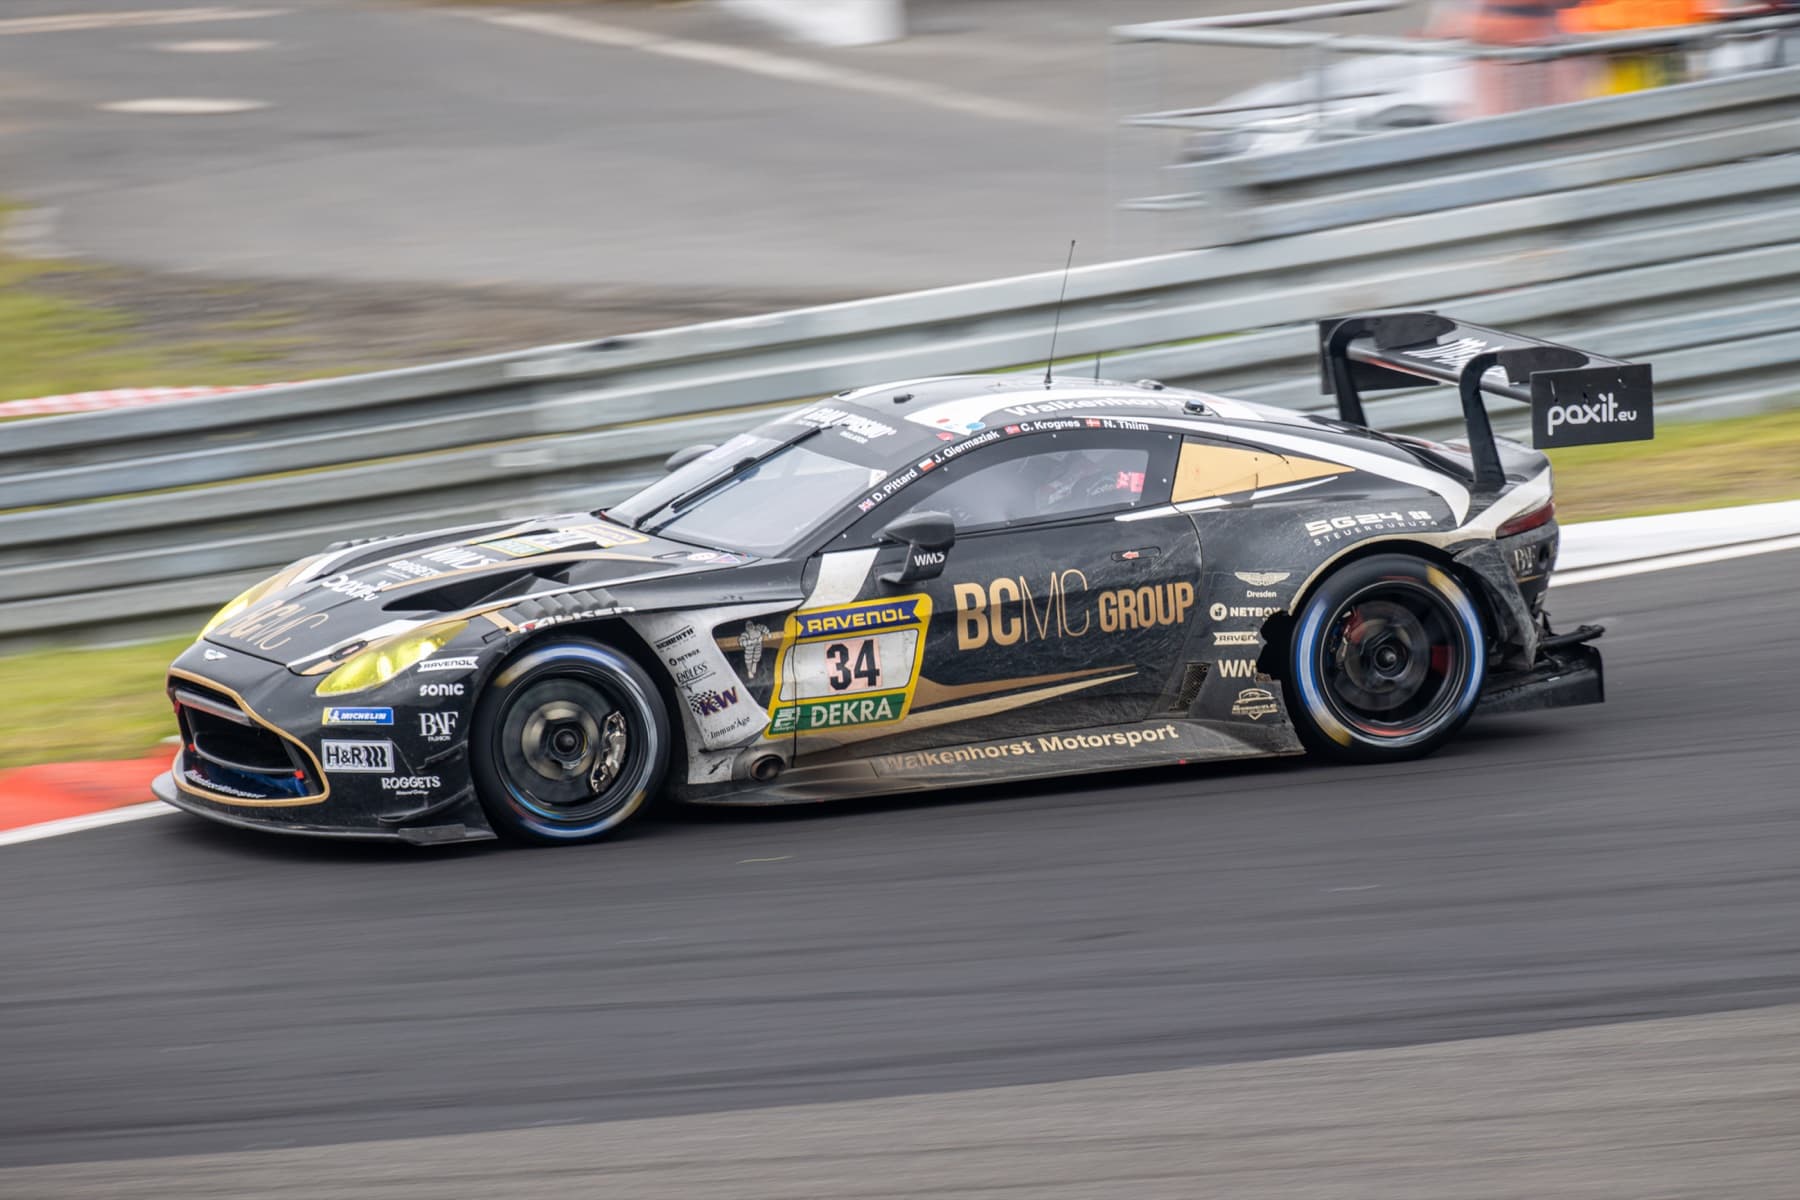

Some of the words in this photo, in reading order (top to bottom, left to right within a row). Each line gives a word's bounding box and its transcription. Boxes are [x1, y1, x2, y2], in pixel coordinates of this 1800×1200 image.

[1020, 421, 1034, 432] C.
[1034, 418, 1081, 431] Krognes
[1103, 419, 1116, 429] N.
[1118, 420, 1150, 431] Thiim
[934, 453, 945, 465] J.
[943, 430, 1000, 458] Giermaziak
[872, 491, 887, 503] D.
[883, 468, 918, 495] Pittard
[1305, 511, 1404, 537] SG24
[913, 551, 945, 567] WMS
[1246, 590, 1277, 598] Dresden
[807, 607, 911, 633] RAVENOL
[953, 568, 1090, 651] BCMC
[1098, 581, 1194, 632] GROUP
[423, 659, 473, 669] RAVENOL
[676, 662, 708, 683] ENDLESS
[826, 639, 881, 691] 34
[699, 686, 739, 717] KW
[811, 697, 893, 728] DEKRA
[340, 712, 387, 721] MICHELIN
[326, 745, 363, 766] H&R
[880, 740, 1035, 771] Walkenhorst
[1038, 723, 1179, 755] Motorsport
[381, 775, 441, 790] ROGGETS
